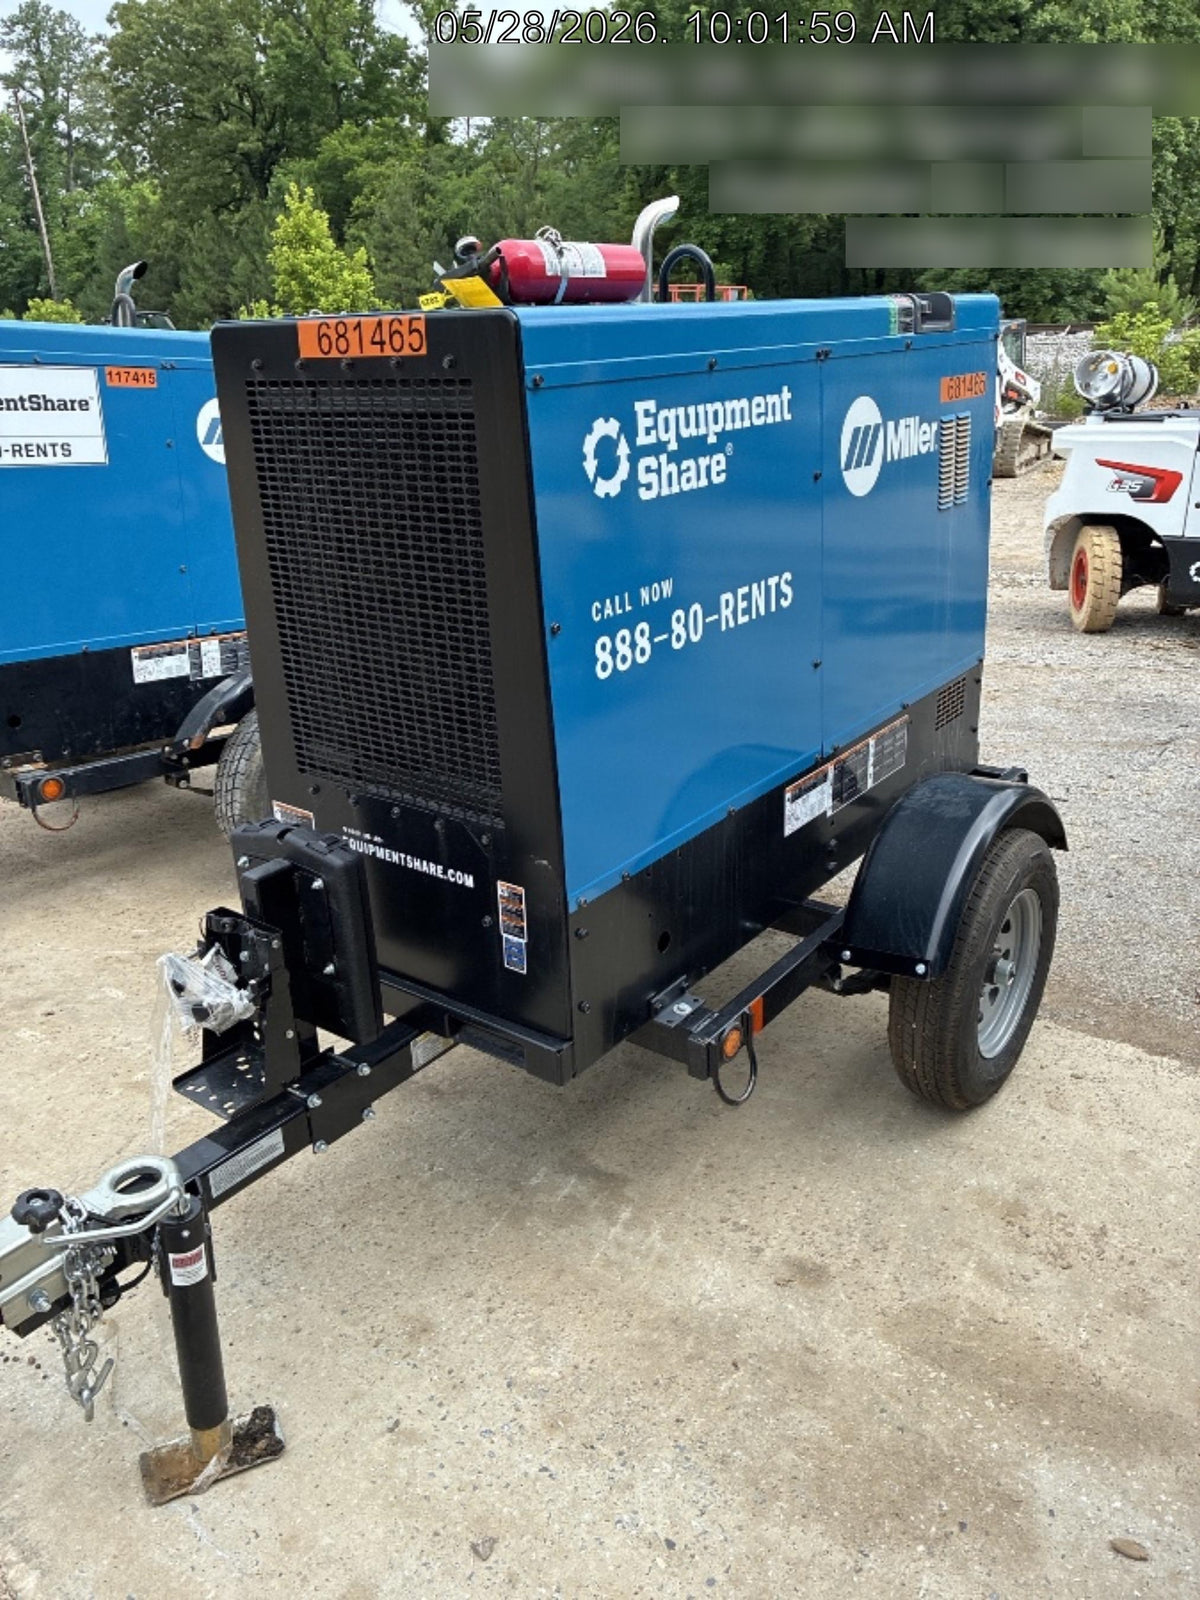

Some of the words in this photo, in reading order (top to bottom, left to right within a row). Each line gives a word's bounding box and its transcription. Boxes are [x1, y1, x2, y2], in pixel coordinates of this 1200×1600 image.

[317, 316, 424, 356] 681465
[106, 370, 156, 385] 117415
[0, 394, 90, 412] ntShare
[634, 384, 792, 452] Equipment
[0, 442, 72, 458] -RENTS
[591, 592, 633, 622] CALL
[639, 577, 674, 607] NOW
[595, 571, 794, 680] 888-80-RENTS
[342, 835, 475, 889] QUIPMENTSHARE.COM
